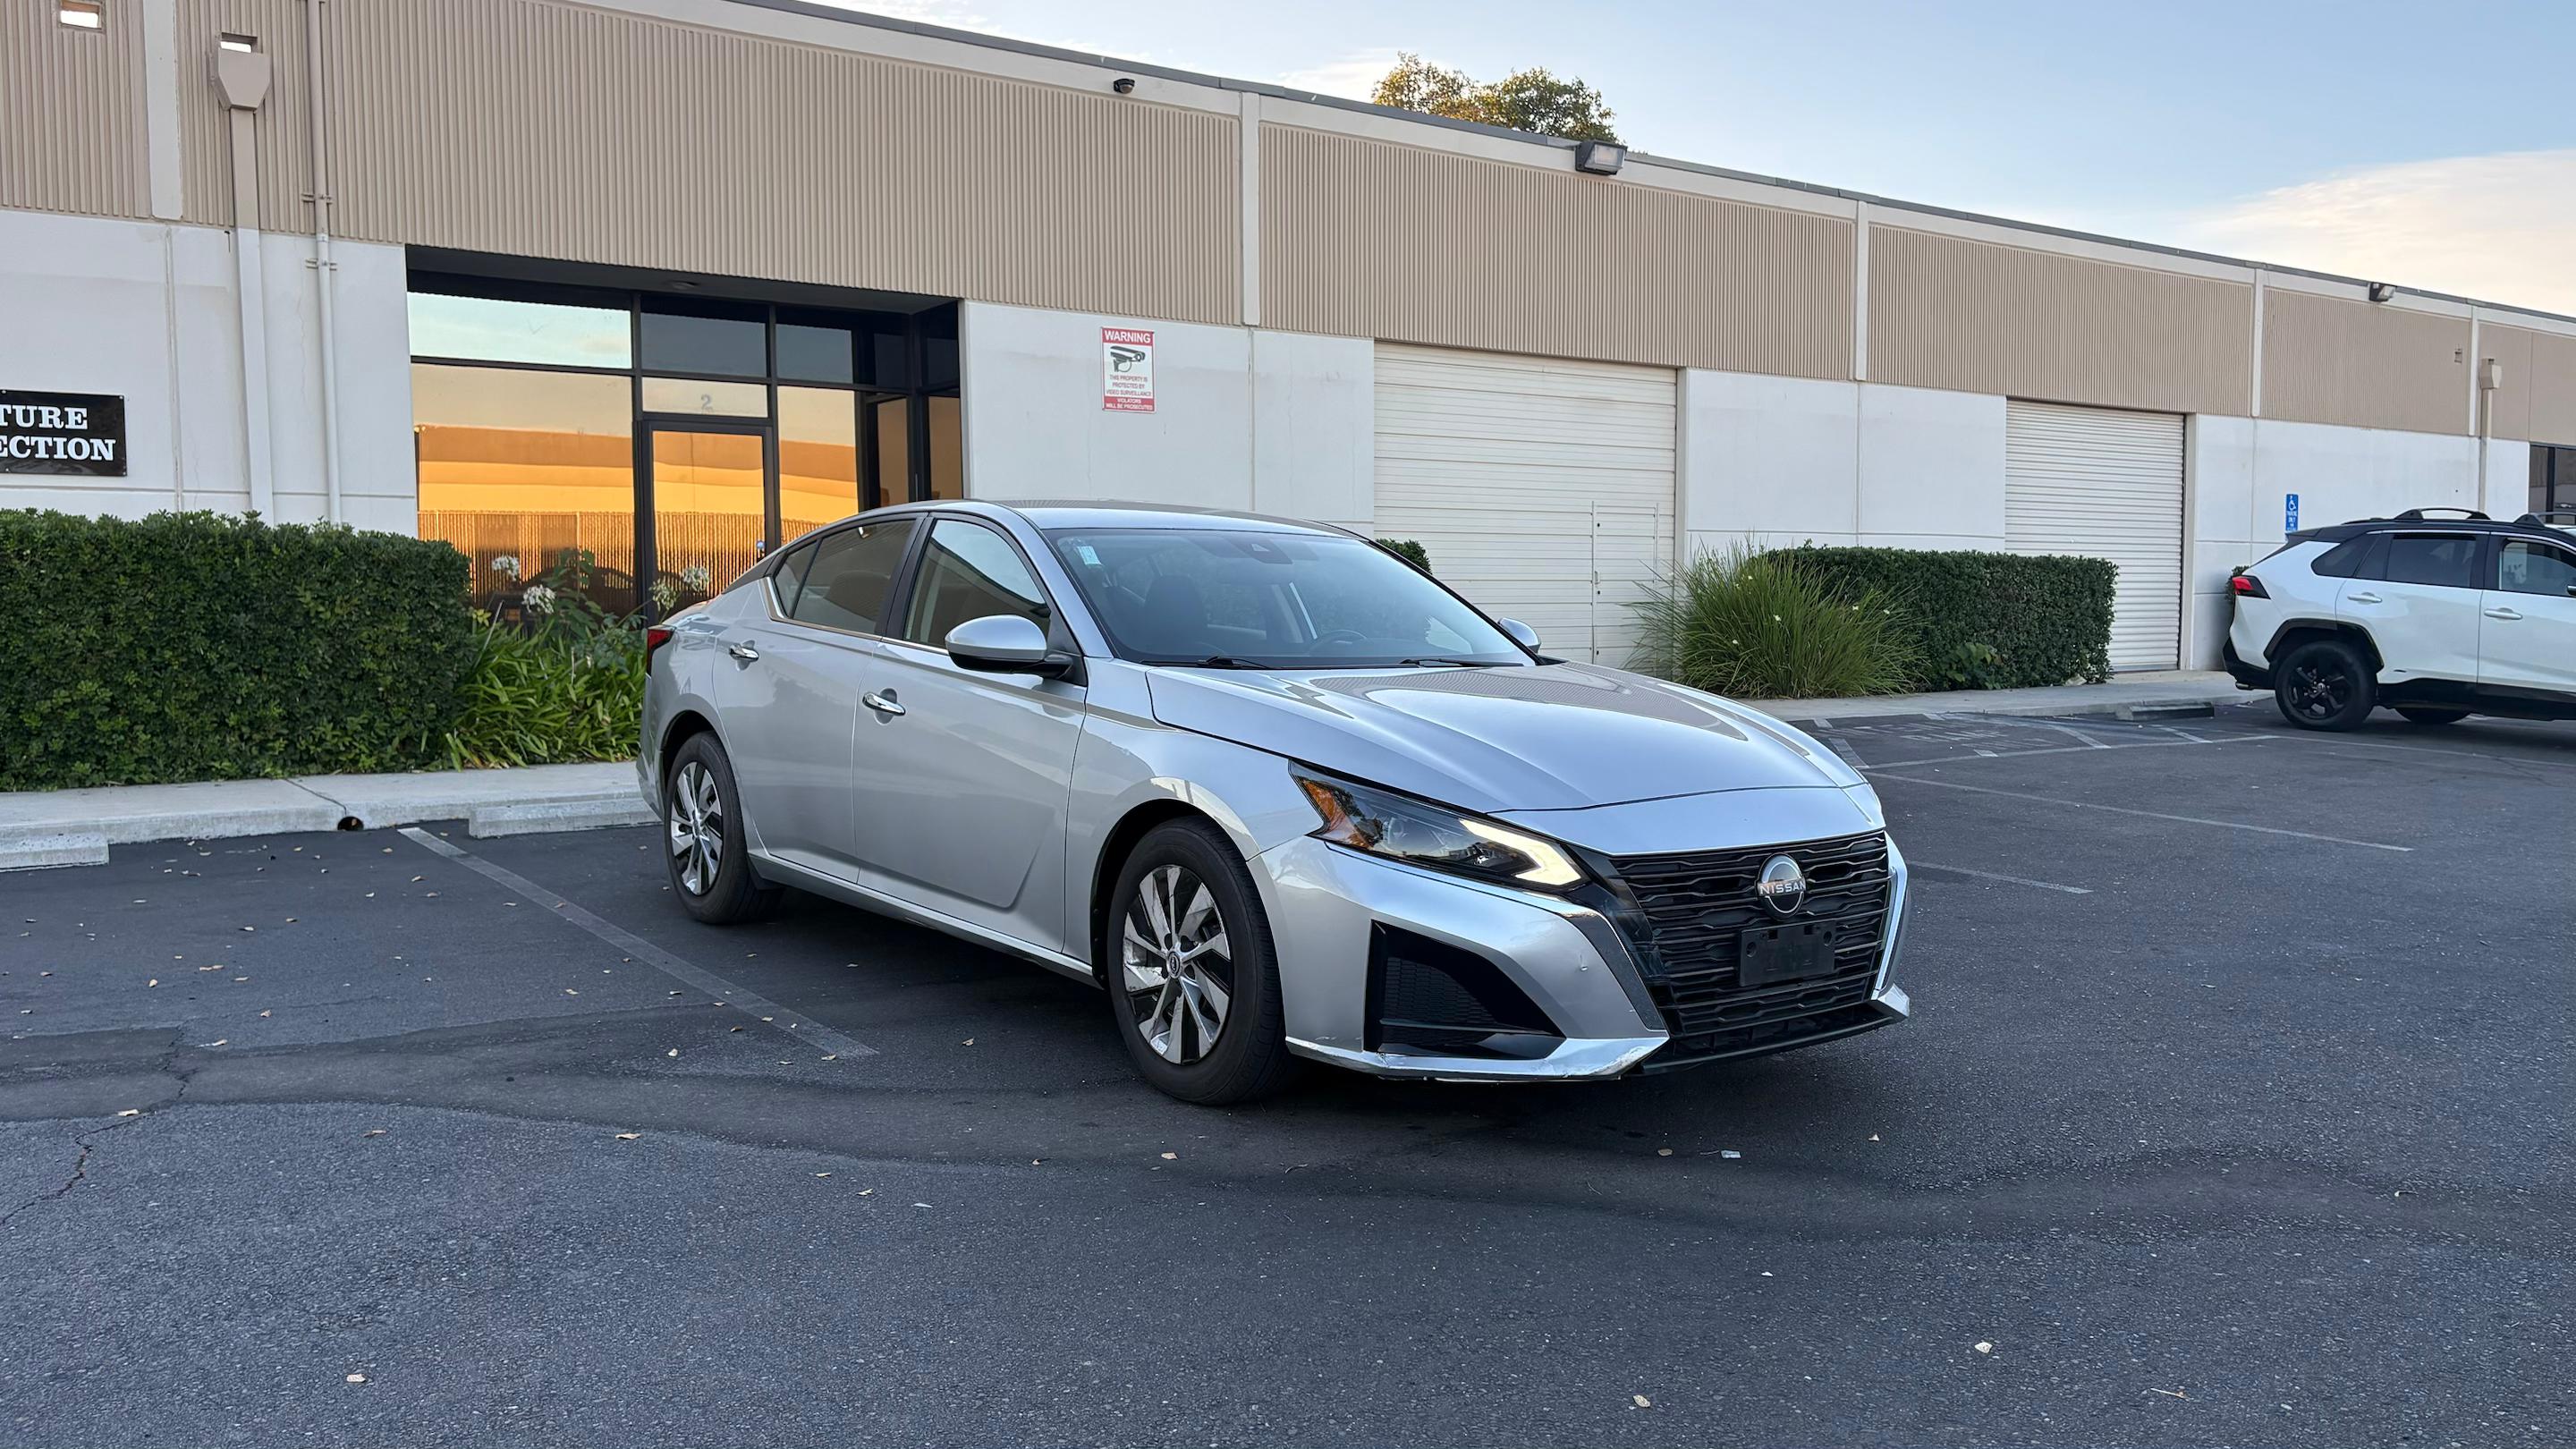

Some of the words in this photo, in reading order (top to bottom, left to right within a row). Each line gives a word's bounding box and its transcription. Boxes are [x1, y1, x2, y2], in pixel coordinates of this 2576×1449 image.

[1105, 330, 1151, 343] WARNING
[1120, 375, 1143, 383] PROPERTY
[701, 394, 713, 411] 2
[1759, 880, 1806, 894] NISSAN
